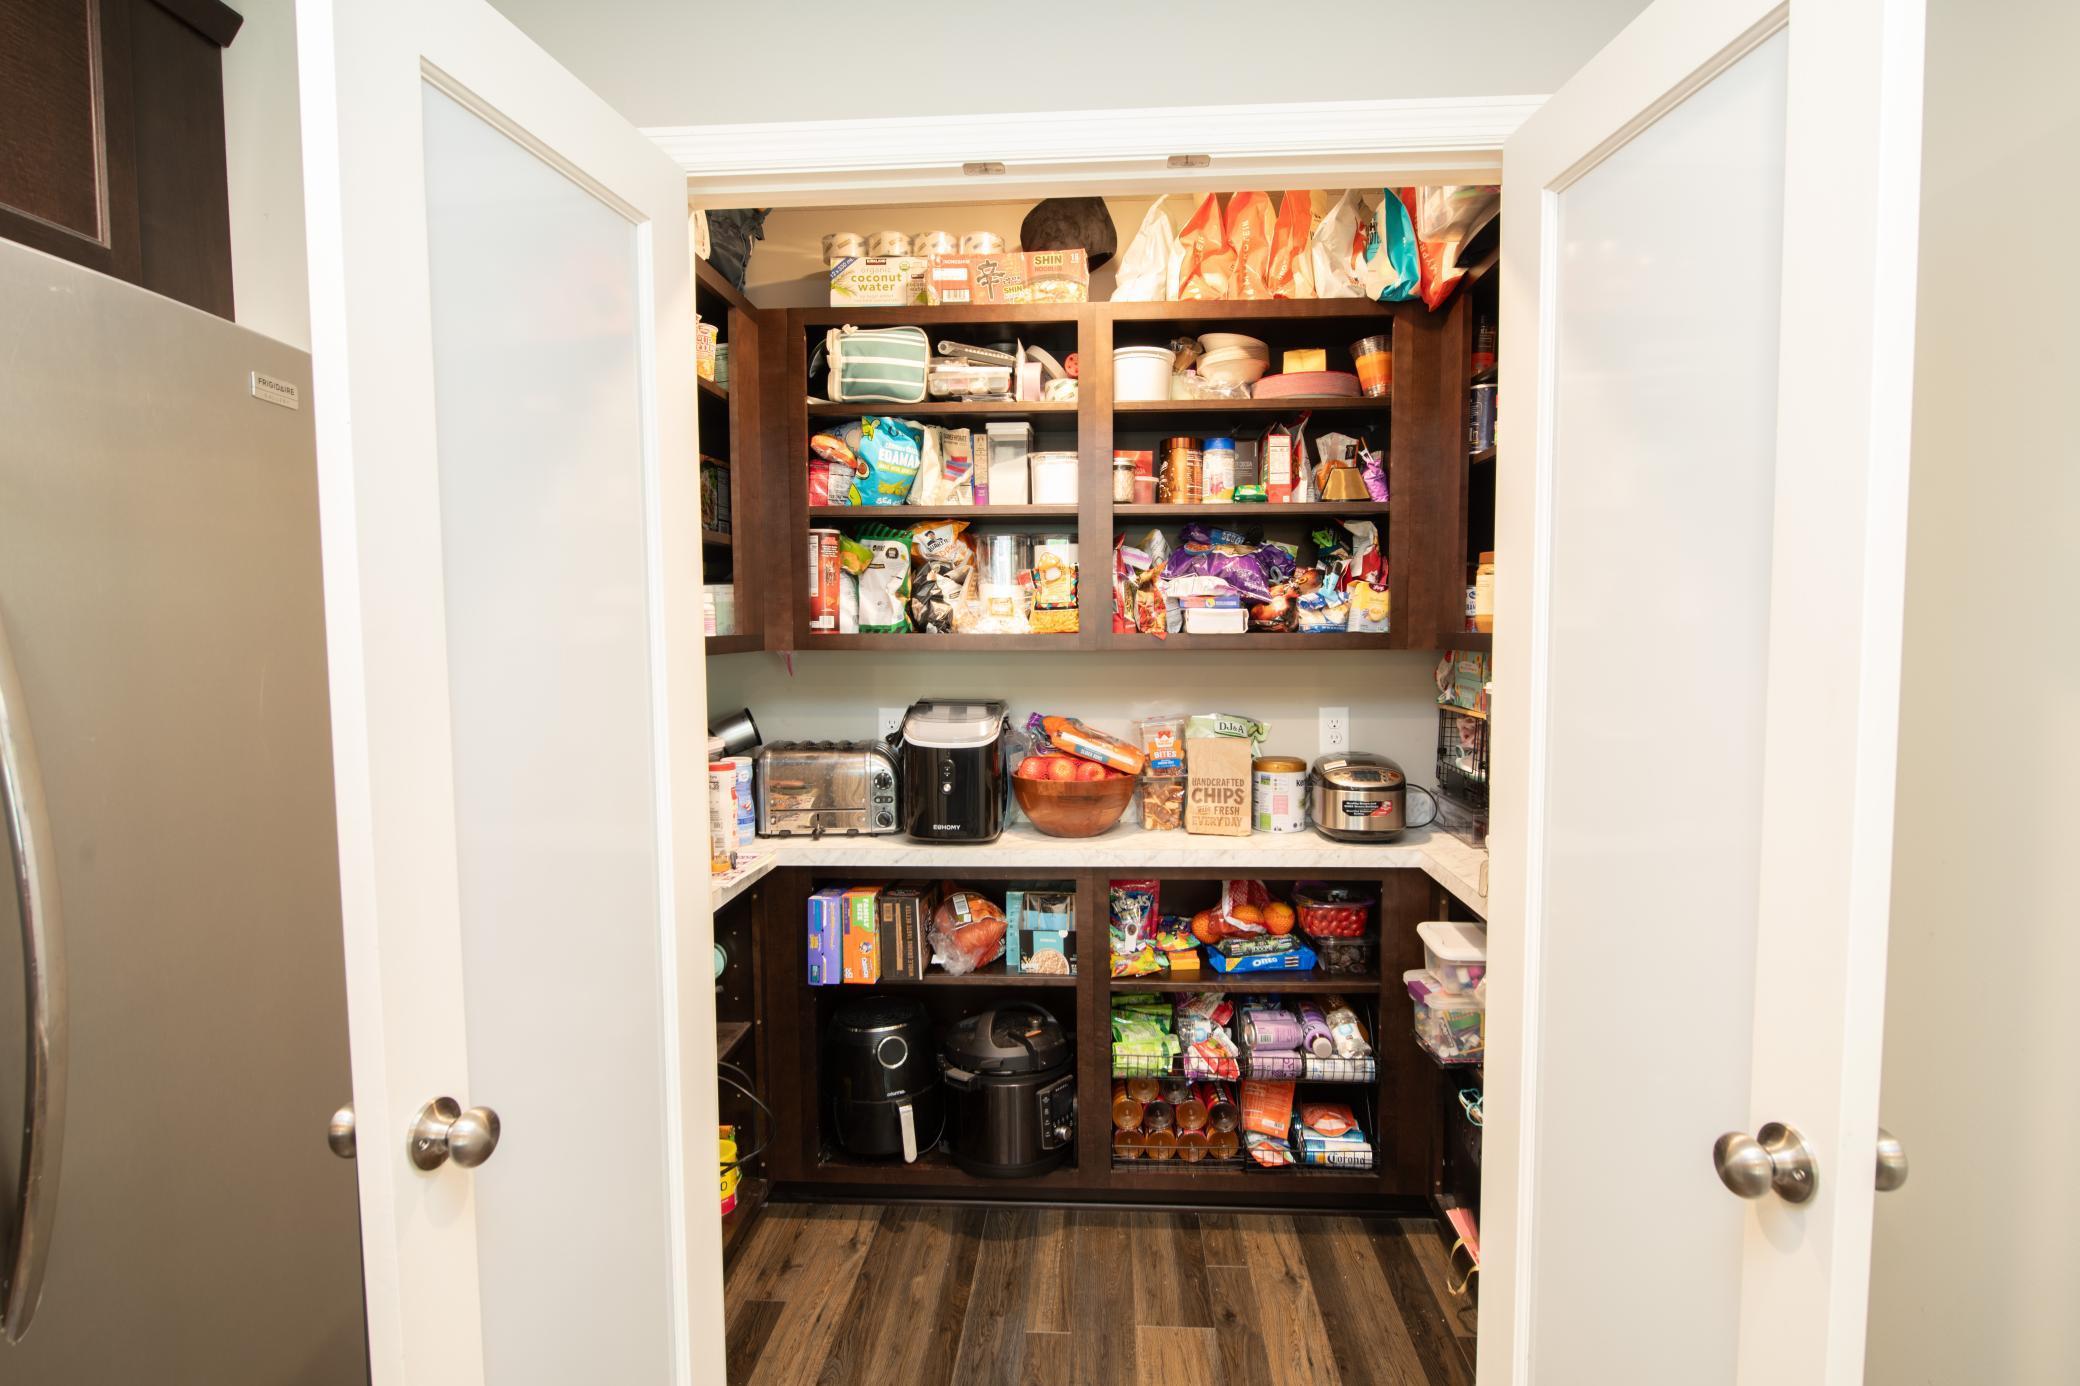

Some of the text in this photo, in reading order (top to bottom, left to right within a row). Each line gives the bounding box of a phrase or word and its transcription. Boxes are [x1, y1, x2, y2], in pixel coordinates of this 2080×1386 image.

[1035, 254, 1063, 266] SHIN
[850, 272, 903, 283] coconut
[976, 259, 1006, 301] 辛
[857, 282, 896, 292] water
[1003, 285, 1023, 295] SHIN
[257, 377, 296, 397] FRIGIDAIRE
[926, 538, 950, 554] QUAKER
[1219, 722, 1245, 734] DJ&A
[1153, 750, 1177, 759] BITES
[1191, 777, 1245, 787] HANDCRAFTED
[1191, 788, 1245, 805] CHIPS
[1214, 806, 1240, 816] FRESH
[1191, 816, 1243, 828] EVERYDAY
[1252, 957, 1278, 967] OREO
